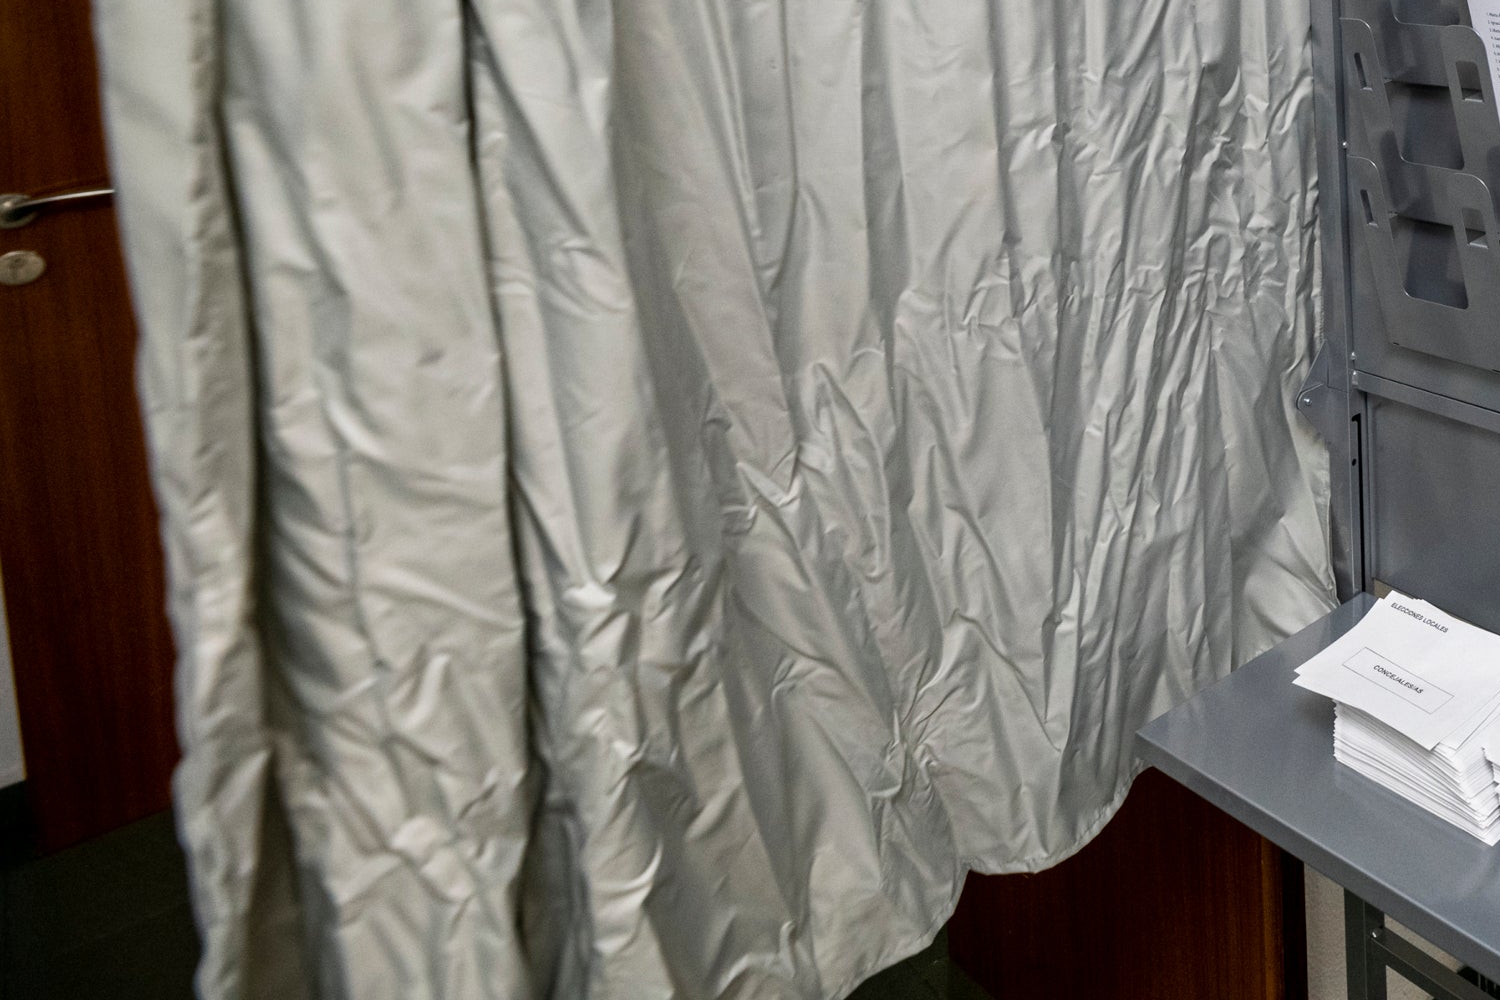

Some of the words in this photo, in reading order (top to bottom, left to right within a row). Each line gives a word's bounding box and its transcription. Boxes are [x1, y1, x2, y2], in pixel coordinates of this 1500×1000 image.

[1391, 603, 1424, 620] ELECCIONES
[1422, 618, 1448, 633] LOCALES
[1374, 665, 1423, 693] CONCEJALES/AS
